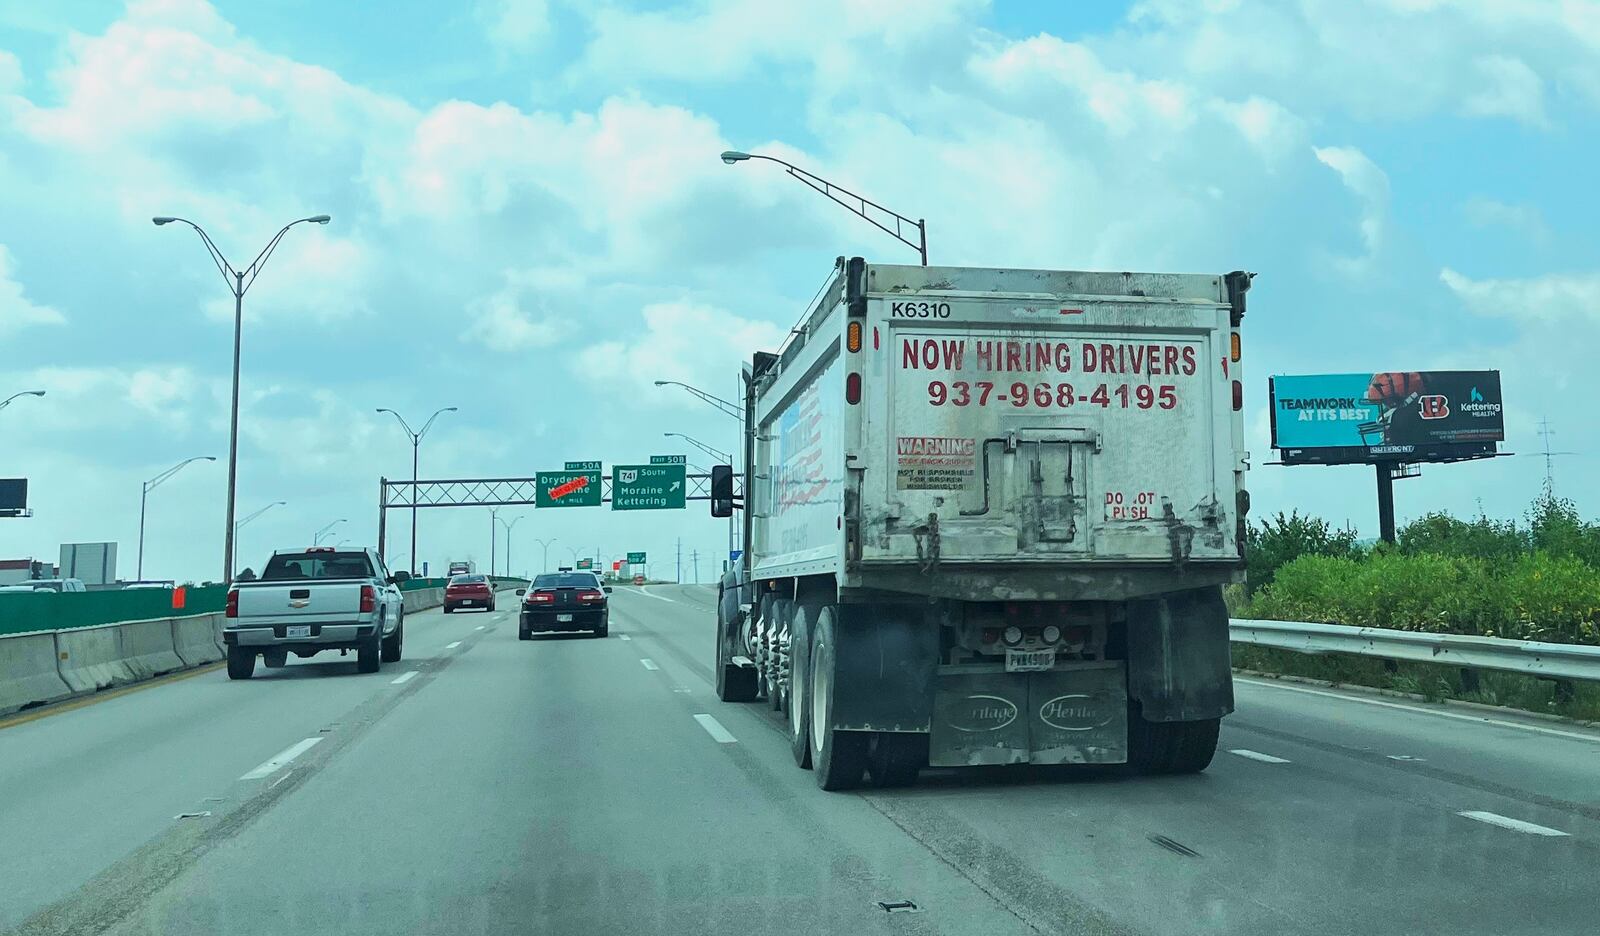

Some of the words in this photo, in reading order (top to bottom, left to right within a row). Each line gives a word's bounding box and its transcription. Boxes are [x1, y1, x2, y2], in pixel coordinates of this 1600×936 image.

[892, 302, 950, 318] K6310
[902, 339, 964, 370] NOW
[976, 341, 1070, 373] HIRING
[1082, 343, 1196, 376] DRIVERS
[928, 380, 1177, 410] 937-968-4195
[1279, 398, 1355, 410] TEAMWORK
[1461, 402, 1501, 412] Kettering
[1298, 410, 1314, 421] AT
[1317, 409, 1337, 421] ITS
[1340, 409, 1370, 420] BEST
[899, 438, 975, 455] WARNING
[621, 472, 636, 480] 741
[621, 486, 663, 495] Moraine
[617, 497, 667, 506] Kettering
[1106, 492, 1123, 504] DO
[1133, 492, 1154, 504] OT
